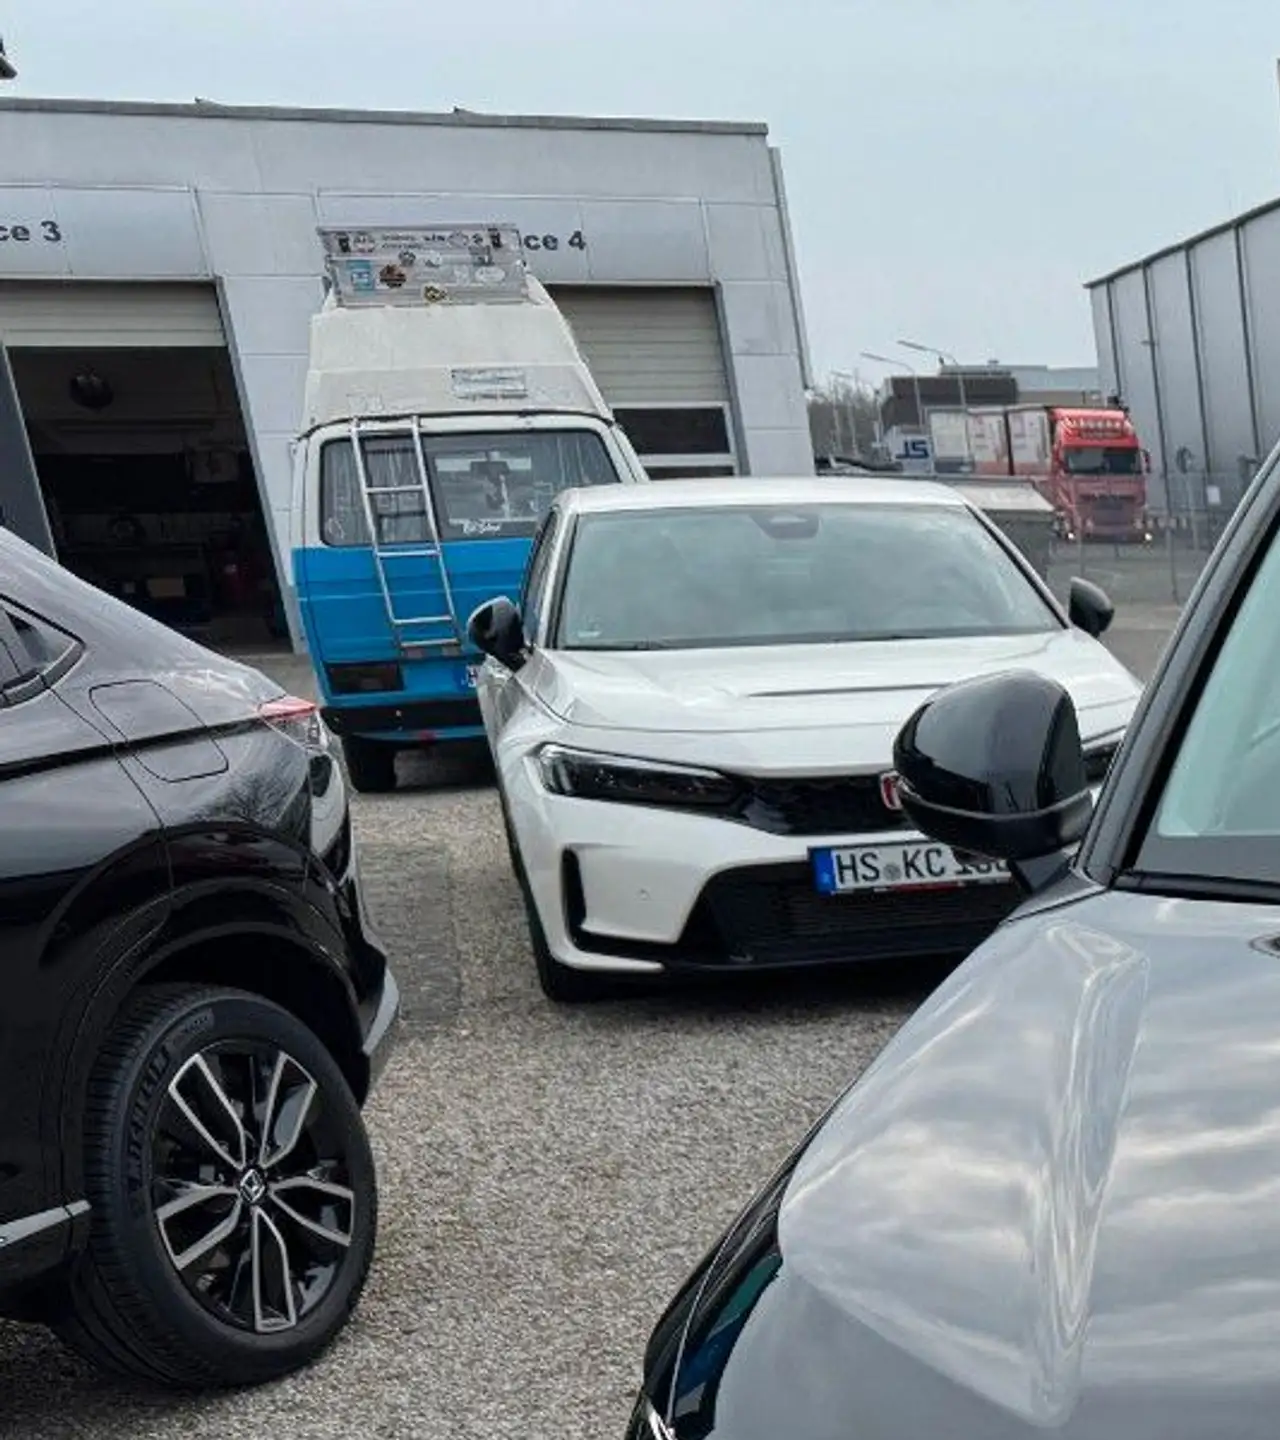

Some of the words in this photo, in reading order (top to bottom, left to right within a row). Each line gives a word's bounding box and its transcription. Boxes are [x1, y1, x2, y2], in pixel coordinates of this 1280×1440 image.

[40, 220, 62, 242] 3
[567, 230, 587, 251] 4
[835, 851, 880, 884] HS
[902, 848, 946, 879] KC
